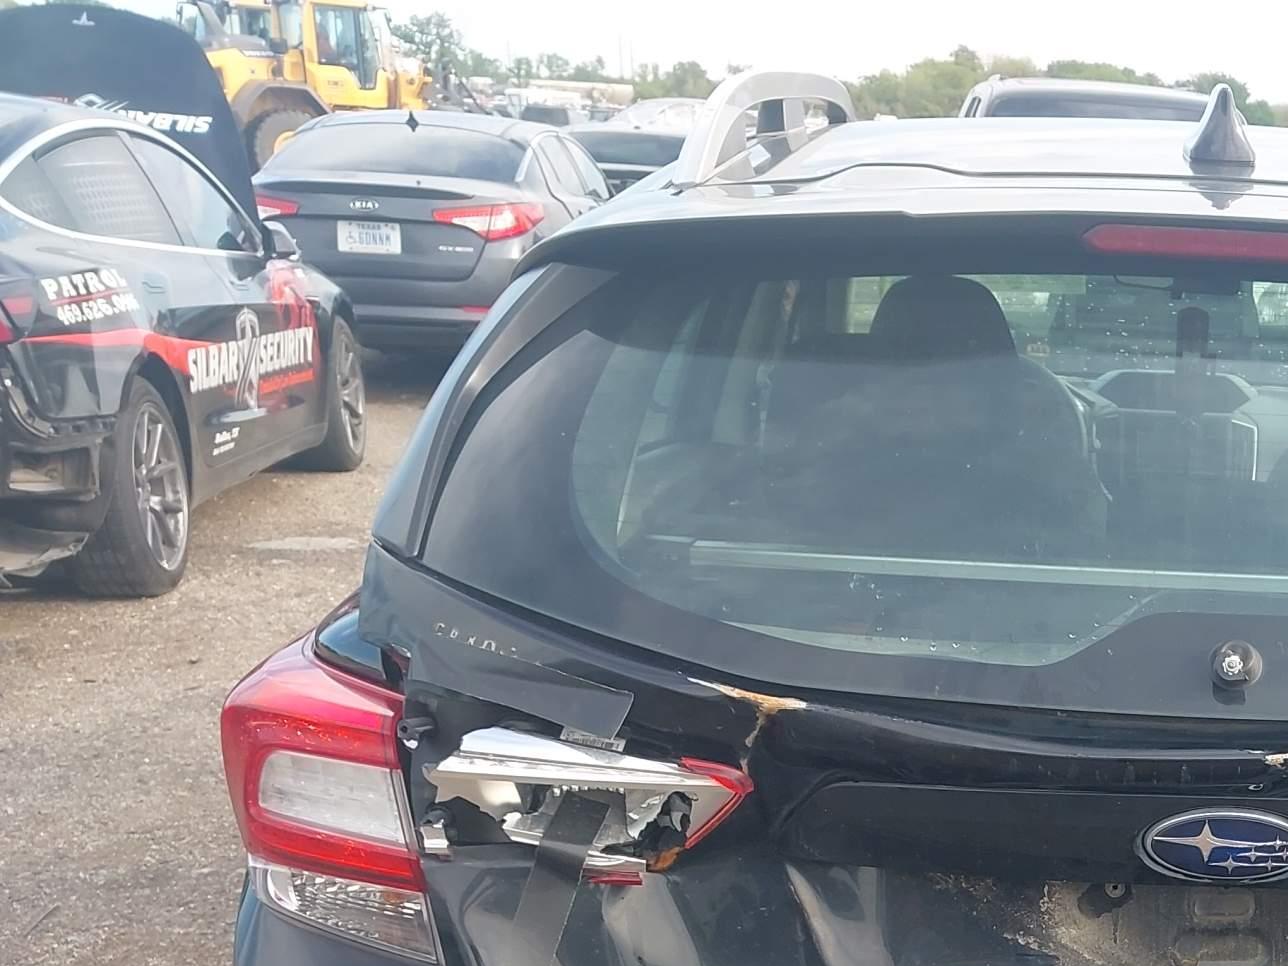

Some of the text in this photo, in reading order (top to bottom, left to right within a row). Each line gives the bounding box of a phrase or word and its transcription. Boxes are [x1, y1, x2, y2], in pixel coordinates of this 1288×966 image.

[40, 268, 128, 301] PATROL
[187, 340, 239, 394] SILBAR
[258, 326, 314, 375] SECURITY
